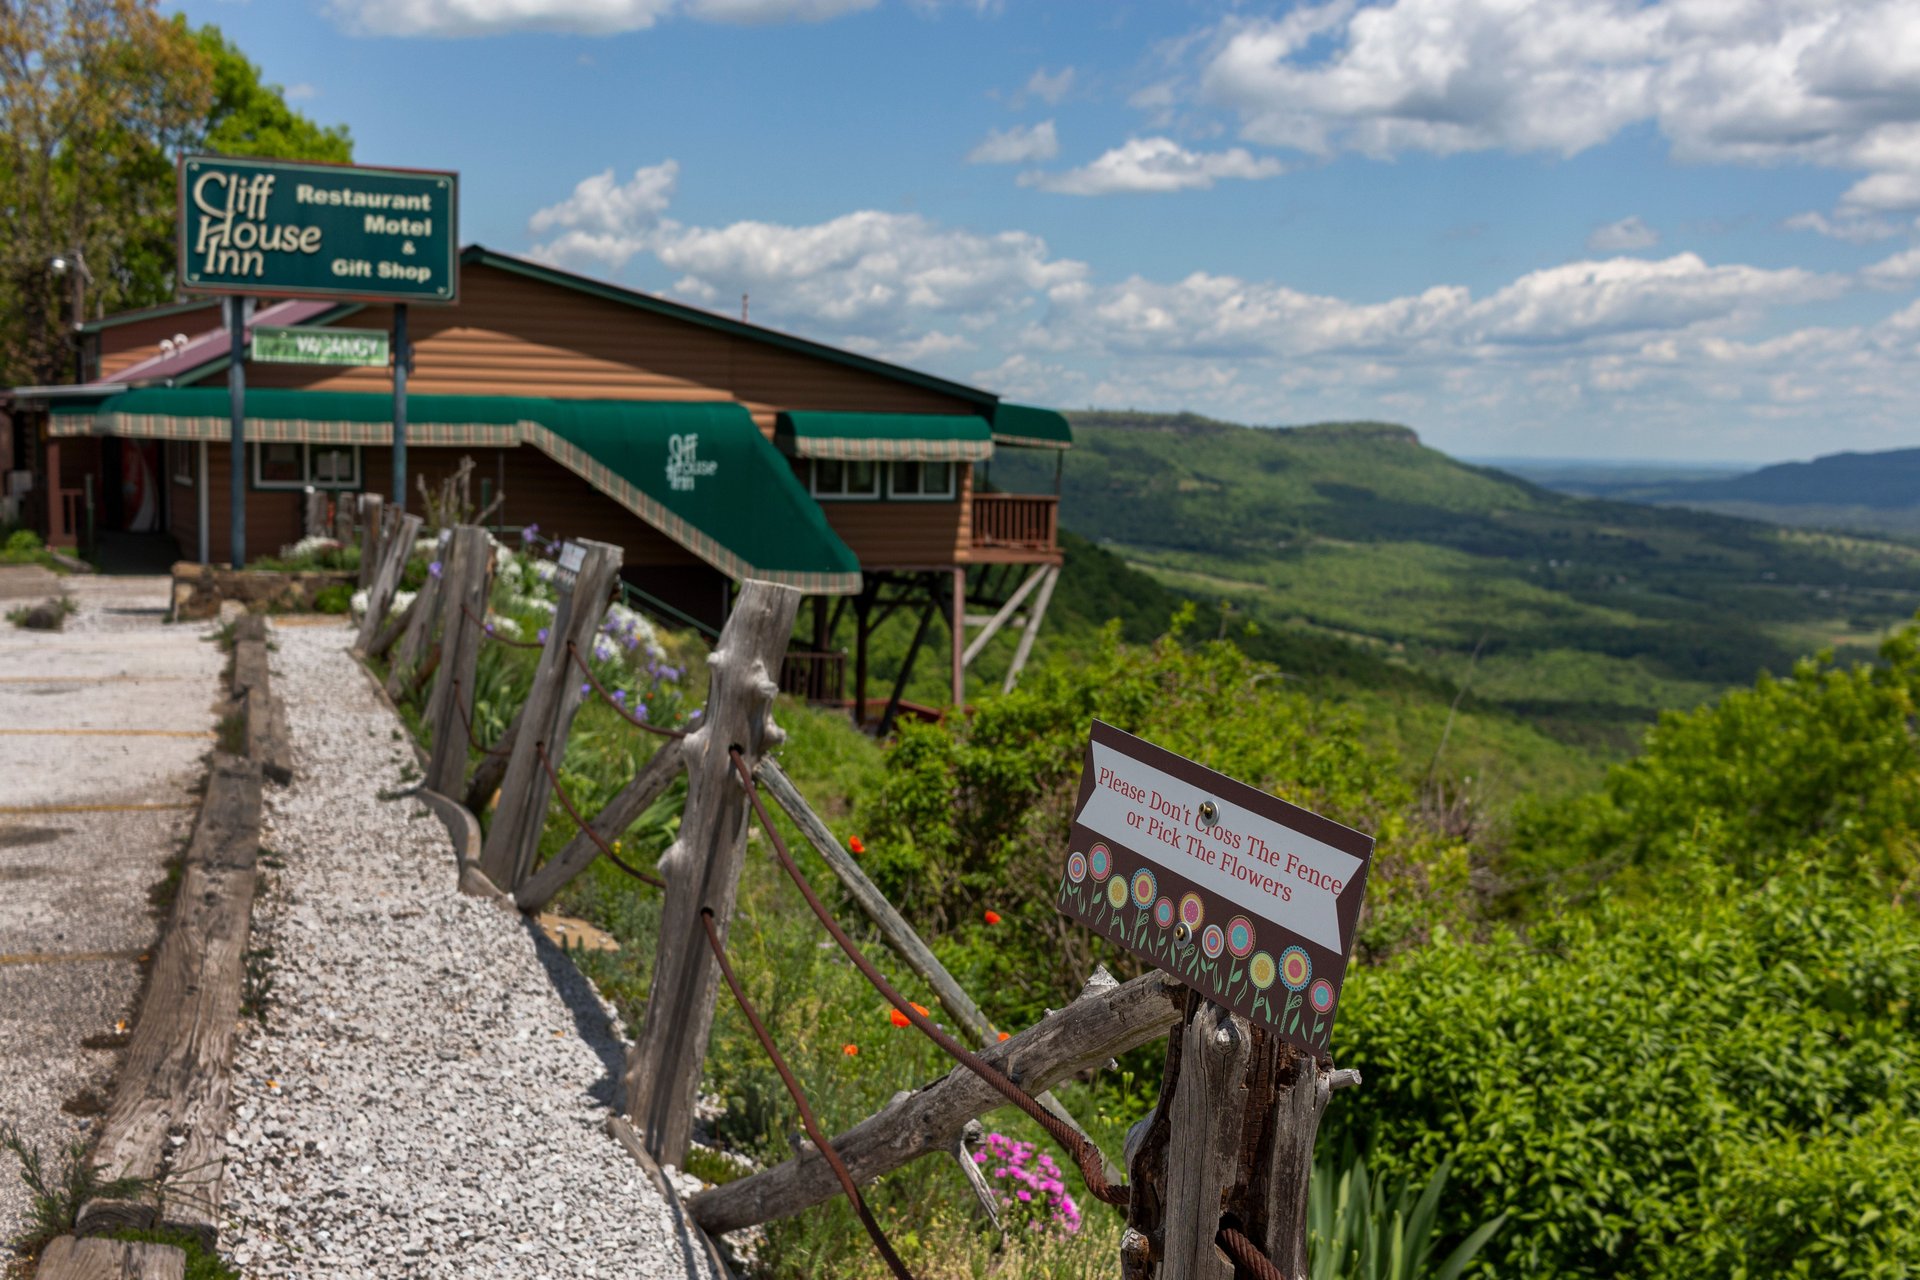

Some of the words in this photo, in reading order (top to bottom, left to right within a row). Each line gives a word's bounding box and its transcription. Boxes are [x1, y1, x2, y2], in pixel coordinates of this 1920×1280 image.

[193, 171, 275, 220] Cliff
[296, 184, 432, 212] Restaurant
[195, 212, 322, 254] House
[364, 213, 432, 237] Motel
[204, 236, 264, 277] Inn
[401, 240, 417, 255] &
[331, 258, 372, 278] Gift
[377, 260, 431, 284] Shop
[296, 335, 378, 357] VACANCY
[1098, 767, 1146, 804] Please
[1149, 790, 1191, 826] Don't
[1247, 835, 1280, 867] The
[1284, 853, 1343, 896] Fence
[1126, 811, 1144, 829] or
[1146, 816, 1181, 850] Pick
[1186, 834, 1216, 866] The
[1219, 852, 1293, 902] Flowers
